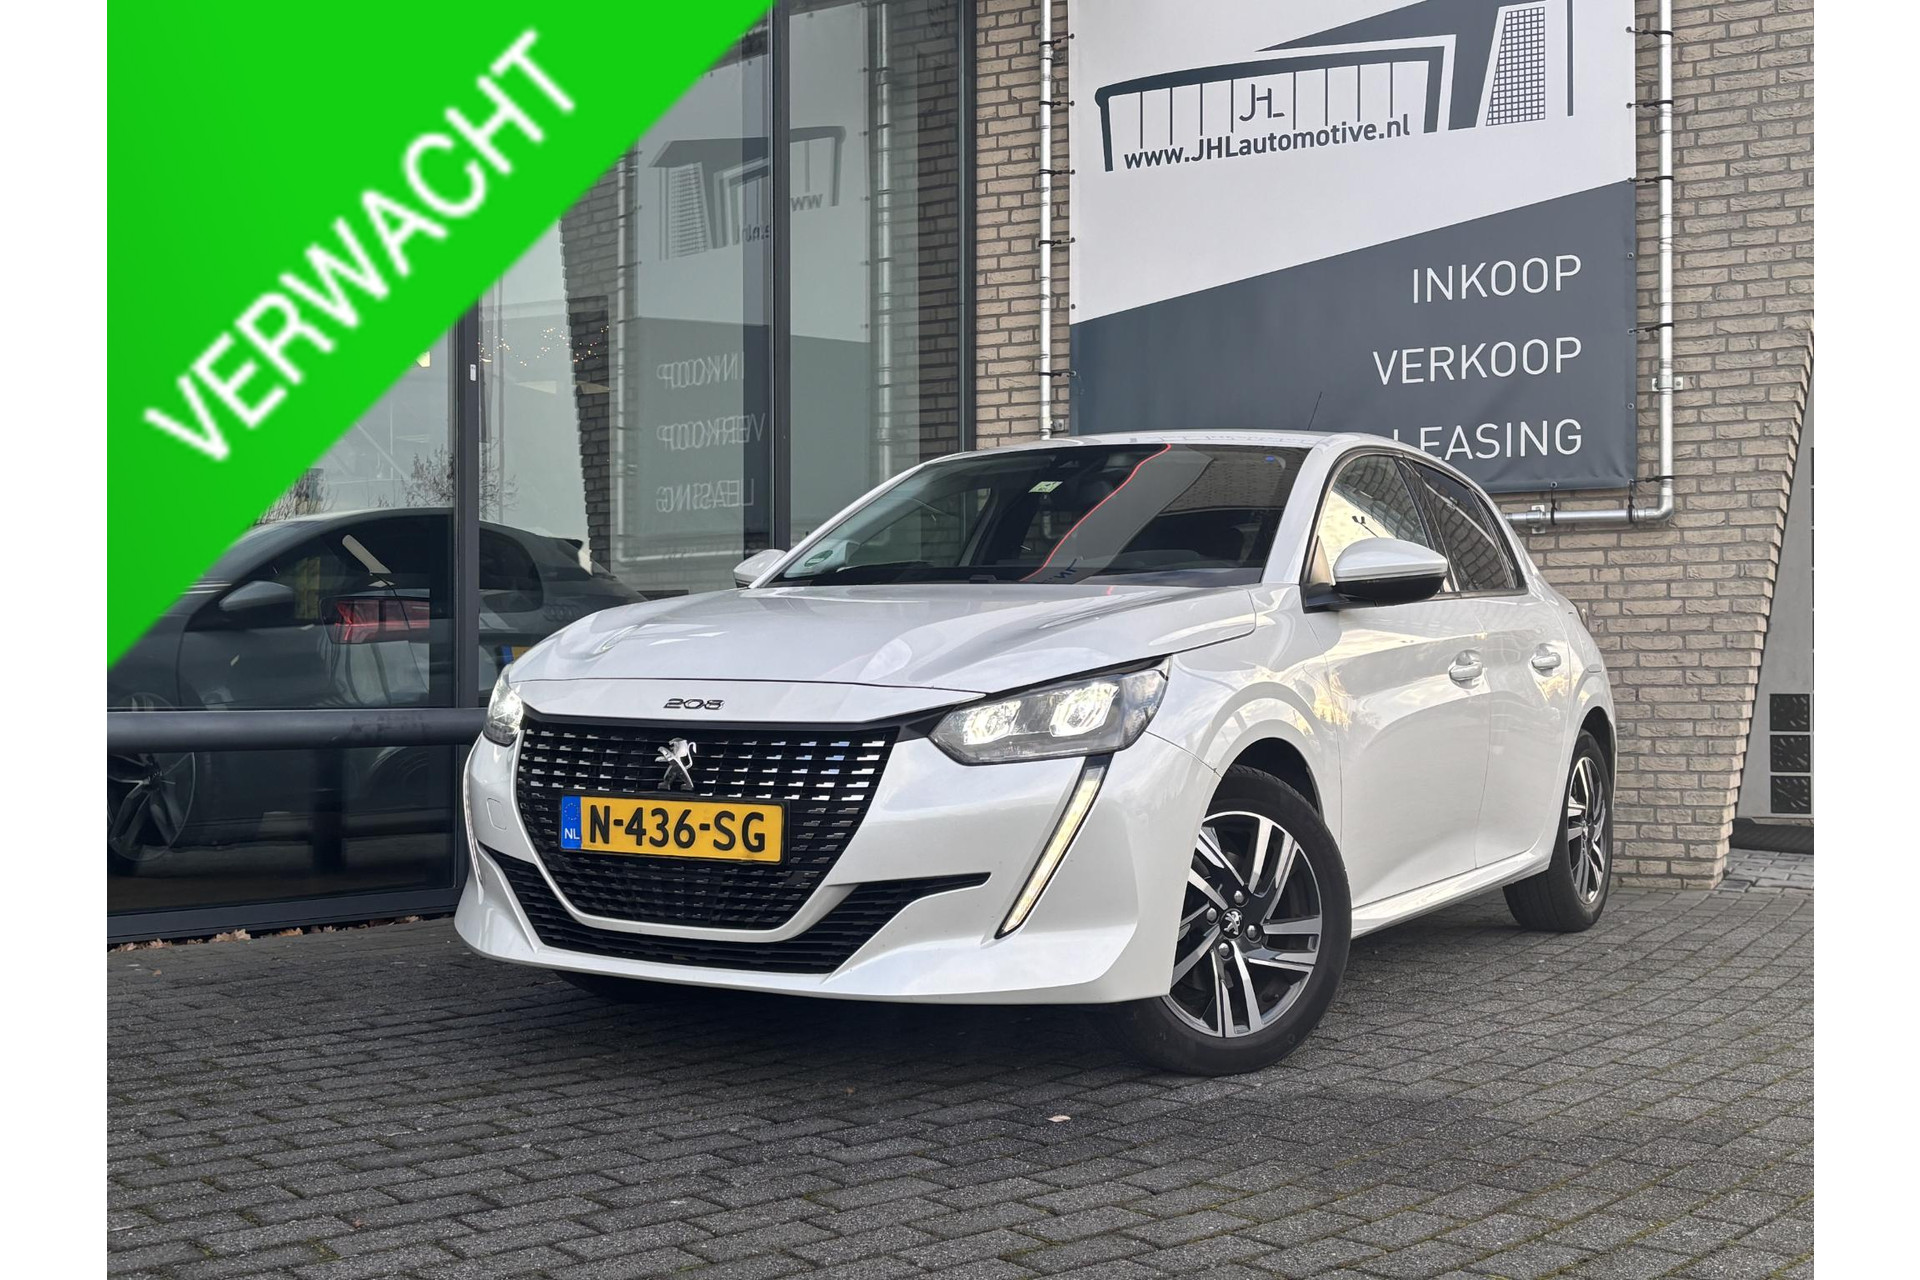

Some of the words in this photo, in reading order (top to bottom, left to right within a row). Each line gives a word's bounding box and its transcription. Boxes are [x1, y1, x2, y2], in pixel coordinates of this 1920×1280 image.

[1239, 83, 1285, 121] JHL
[1124, 114, 1410, 169] www.JHLautomotive.nl
[1413, 254, 1581, 303] INKOOP
[1372, 336, 1582, 385] VERKOOP
[1393, 418, 1582, 460] EASING
[663, 698, 725, 710] 208
[564, 828, 580, 840] NL
[589, 805, 765, 853] N-436-SG
